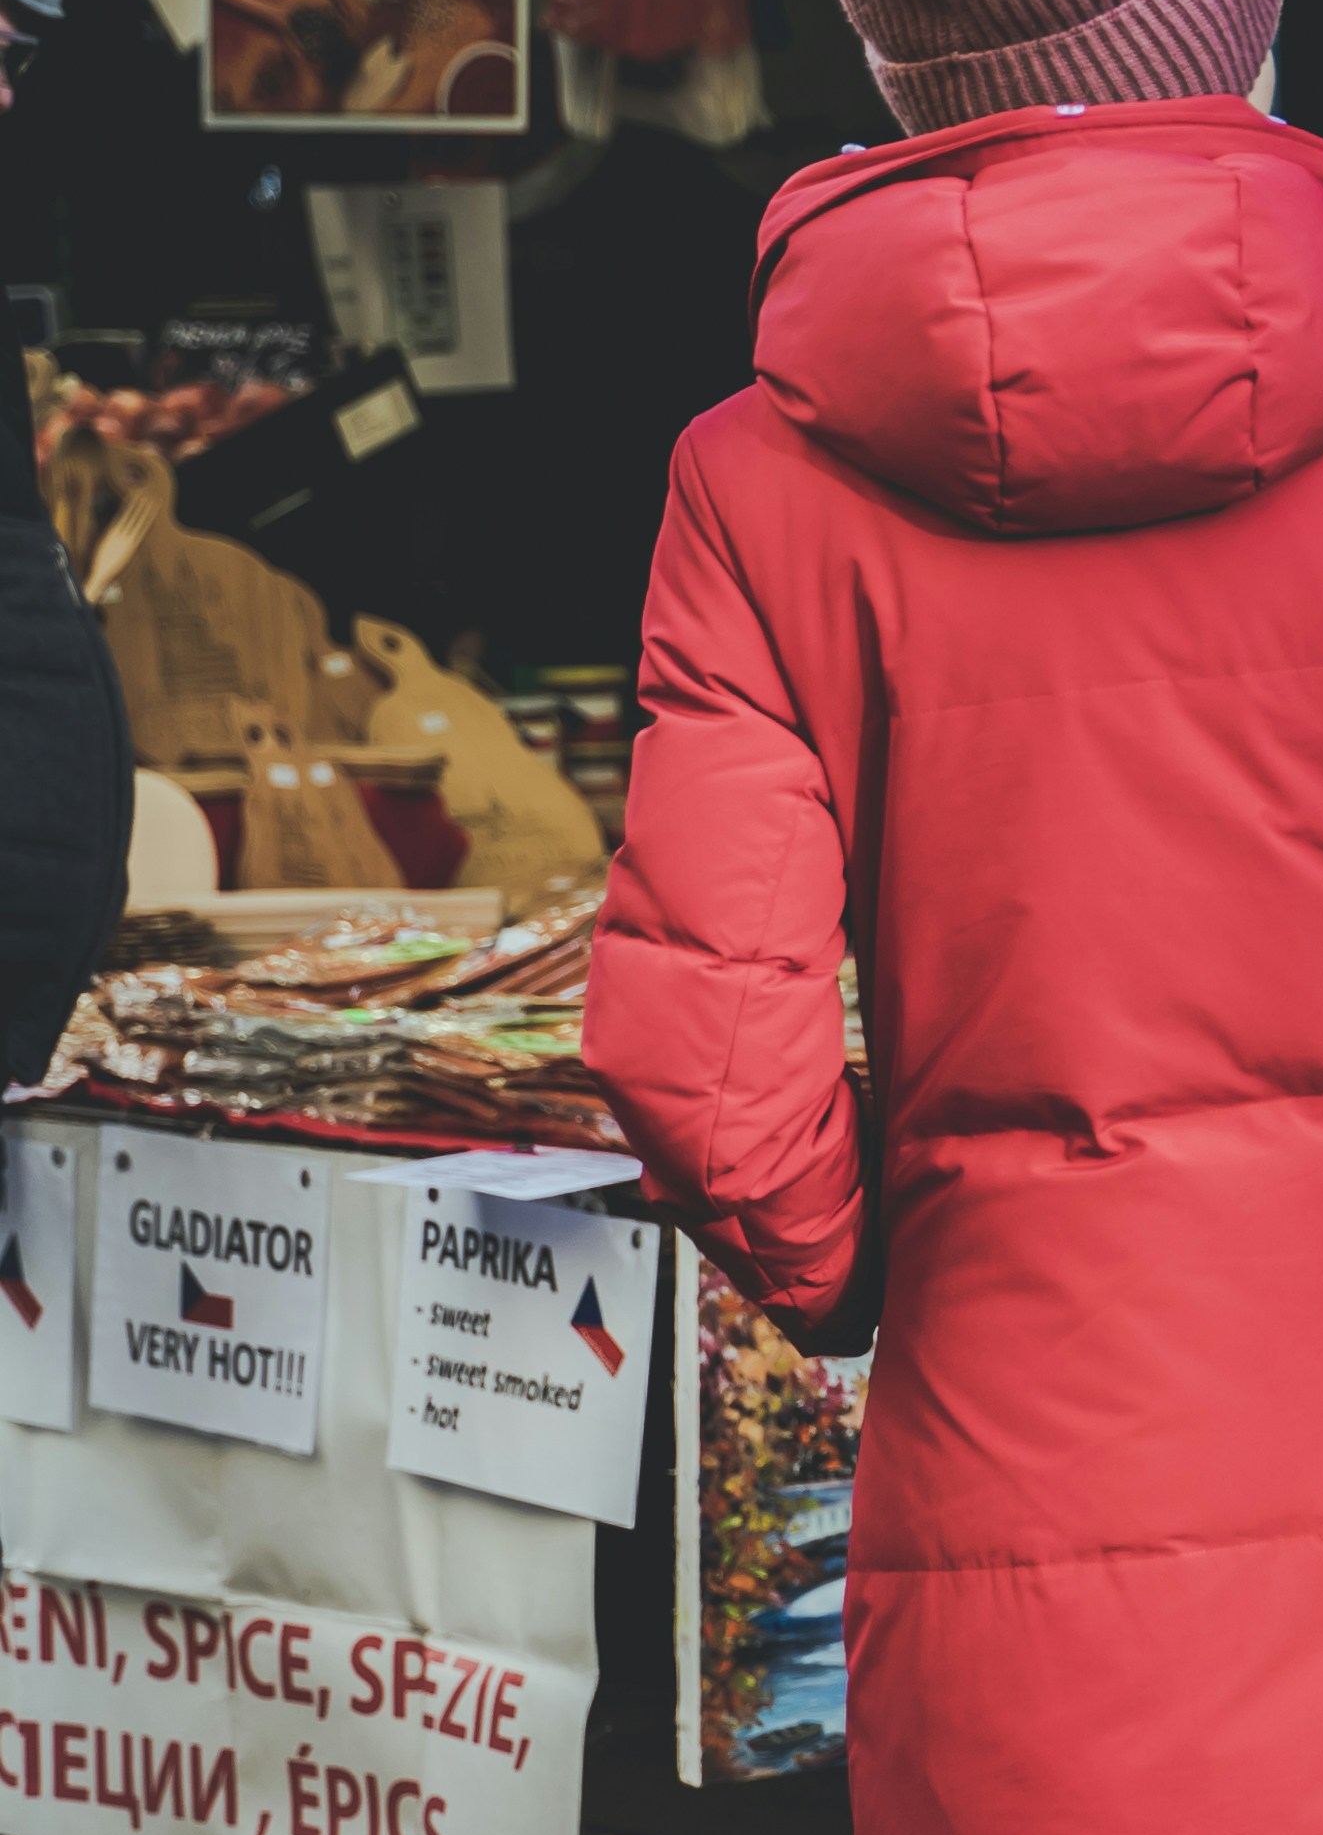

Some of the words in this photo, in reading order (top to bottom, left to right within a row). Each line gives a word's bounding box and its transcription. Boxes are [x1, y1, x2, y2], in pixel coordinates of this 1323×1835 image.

[130, 1198, 313, 1277] GLADIATOR
[421, 1219, 559, 1293] PAPRIKA
[431, 1302, 491, 1338] sweet
[126, 1319, 200, 1375] VERY
[207, 1336, 305, 1397] HOT!!!
[426, 1353, 487, 1390] sweet
[493, 1370, 584, 1411] smoked
[422, 1395, 459, 1432] hot
[145, 1600, 330, 1720] SPICE,
